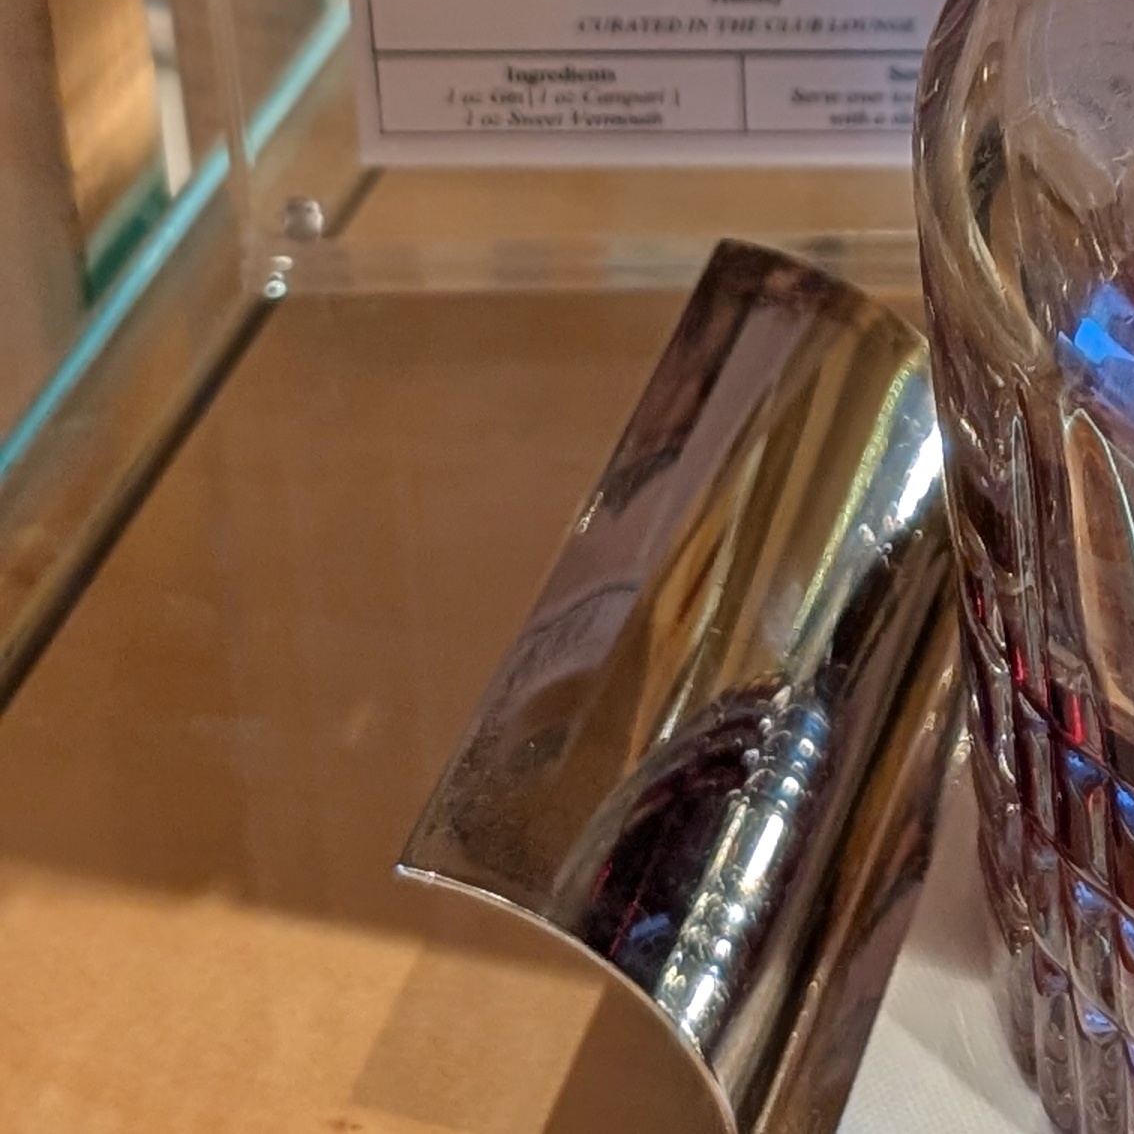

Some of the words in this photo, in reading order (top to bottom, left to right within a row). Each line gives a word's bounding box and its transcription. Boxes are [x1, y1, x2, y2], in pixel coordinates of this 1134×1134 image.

[577, 16, 683, 33] CURATED
[688, 16, 709, 33] IN
[715, 16, 756, 33] THE
[763, 16, 823, 33] CLUB
[506, 66, 617, 85] Ingredients
